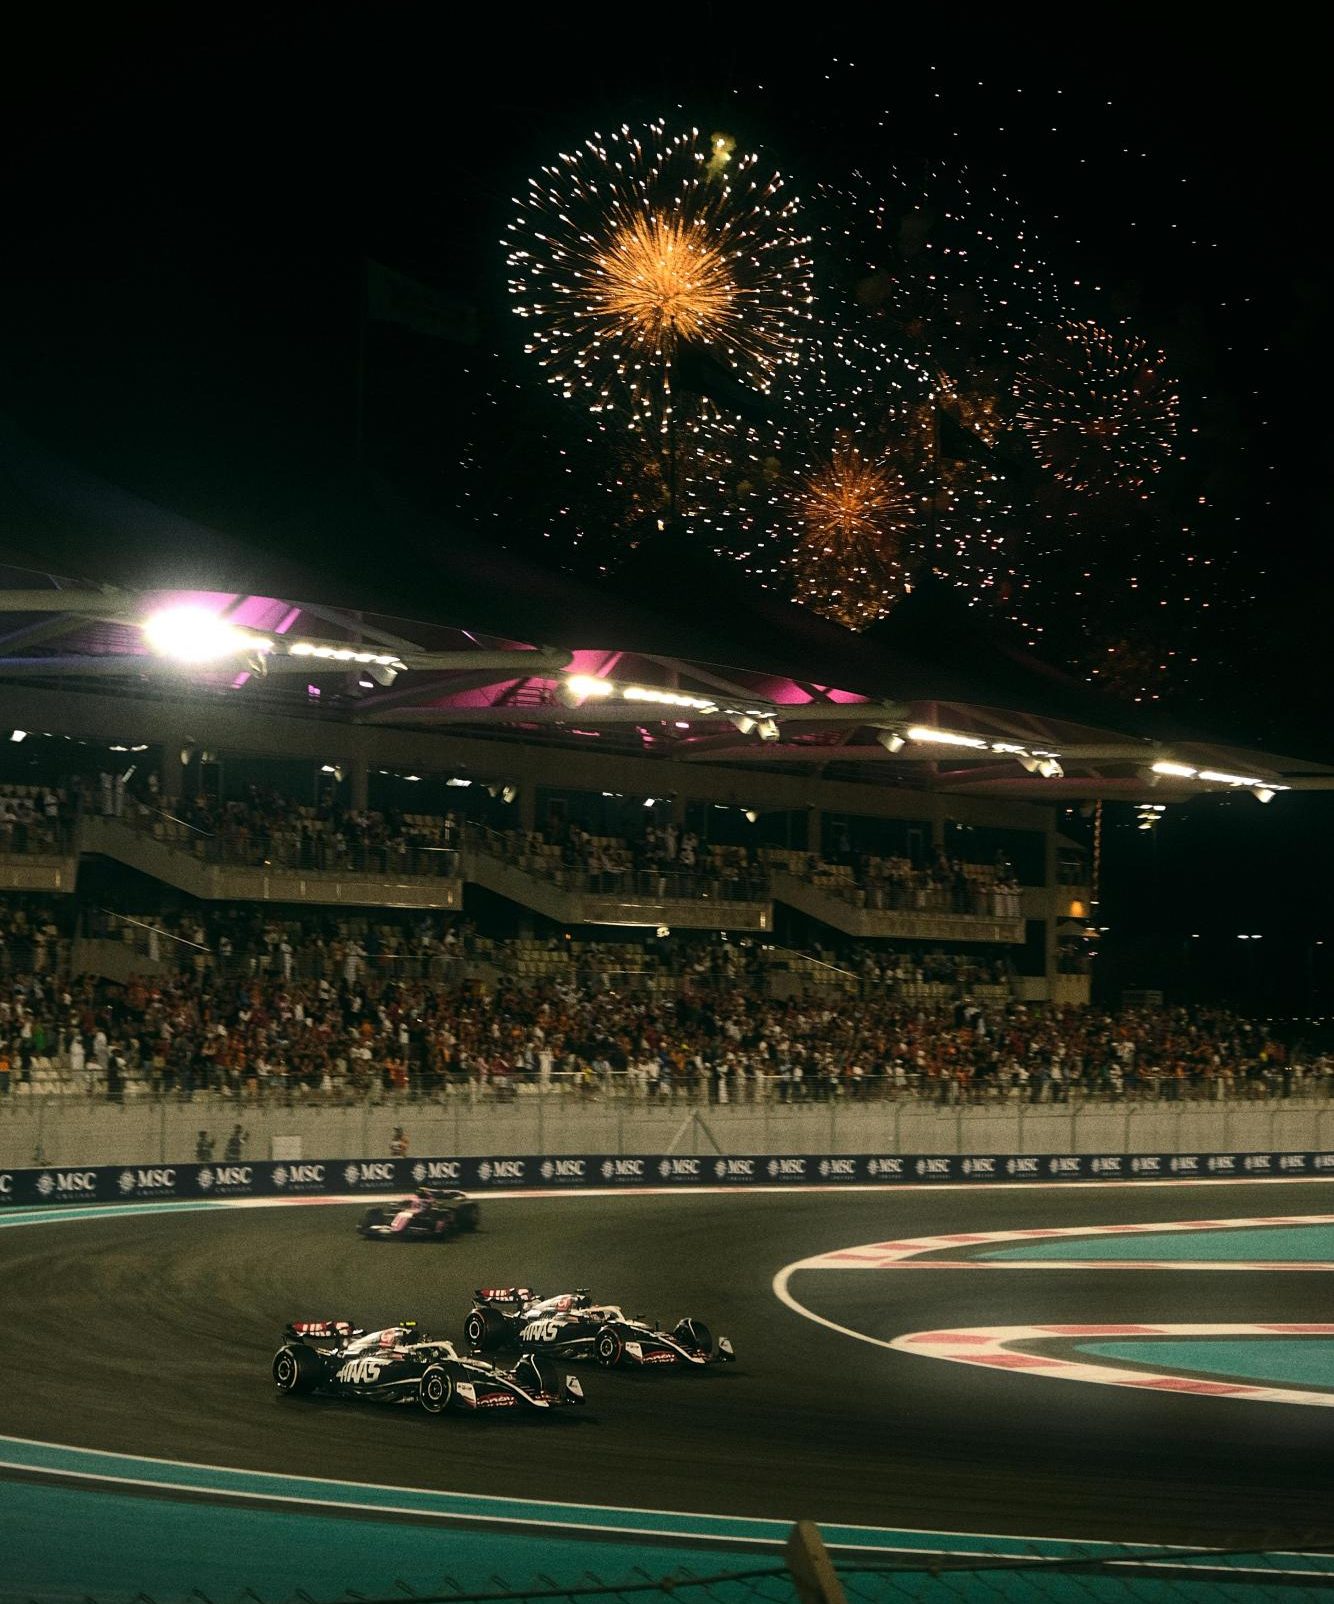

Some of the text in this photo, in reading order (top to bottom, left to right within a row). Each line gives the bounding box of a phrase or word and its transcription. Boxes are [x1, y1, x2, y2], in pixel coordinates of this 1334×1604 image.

[362, 1163, 395, 1180] MSC
[428, 1161, 460, 1178] MSC
[493, 1160, 525, 1177] MSC
[556, 1160, 586, 1176] MSC
[616, 1159, 644, 1175] MSC
[672, 1159, 701, 1174] MSC
[726, 1159, 755, 1175] MSC
[780, 1159, 806, 1174] MSC
[829, 1159, 856, 1174] MSC
[877, 1158, 904, 1173] MSC
[925, 1158, 951, 1173] MSC
[970, 1158, 996, 1172] MSC
[1016, 1158, 1039, 1172] MSC
[1059, 1157, 1081, 1171] MSC
[57, 1172, 97, 1191] MSC
[138, 1169, 176, 1188] MSC
[216, 1166, 252, 1185] MSC
[290, 1164, 325, 1183] MSC
